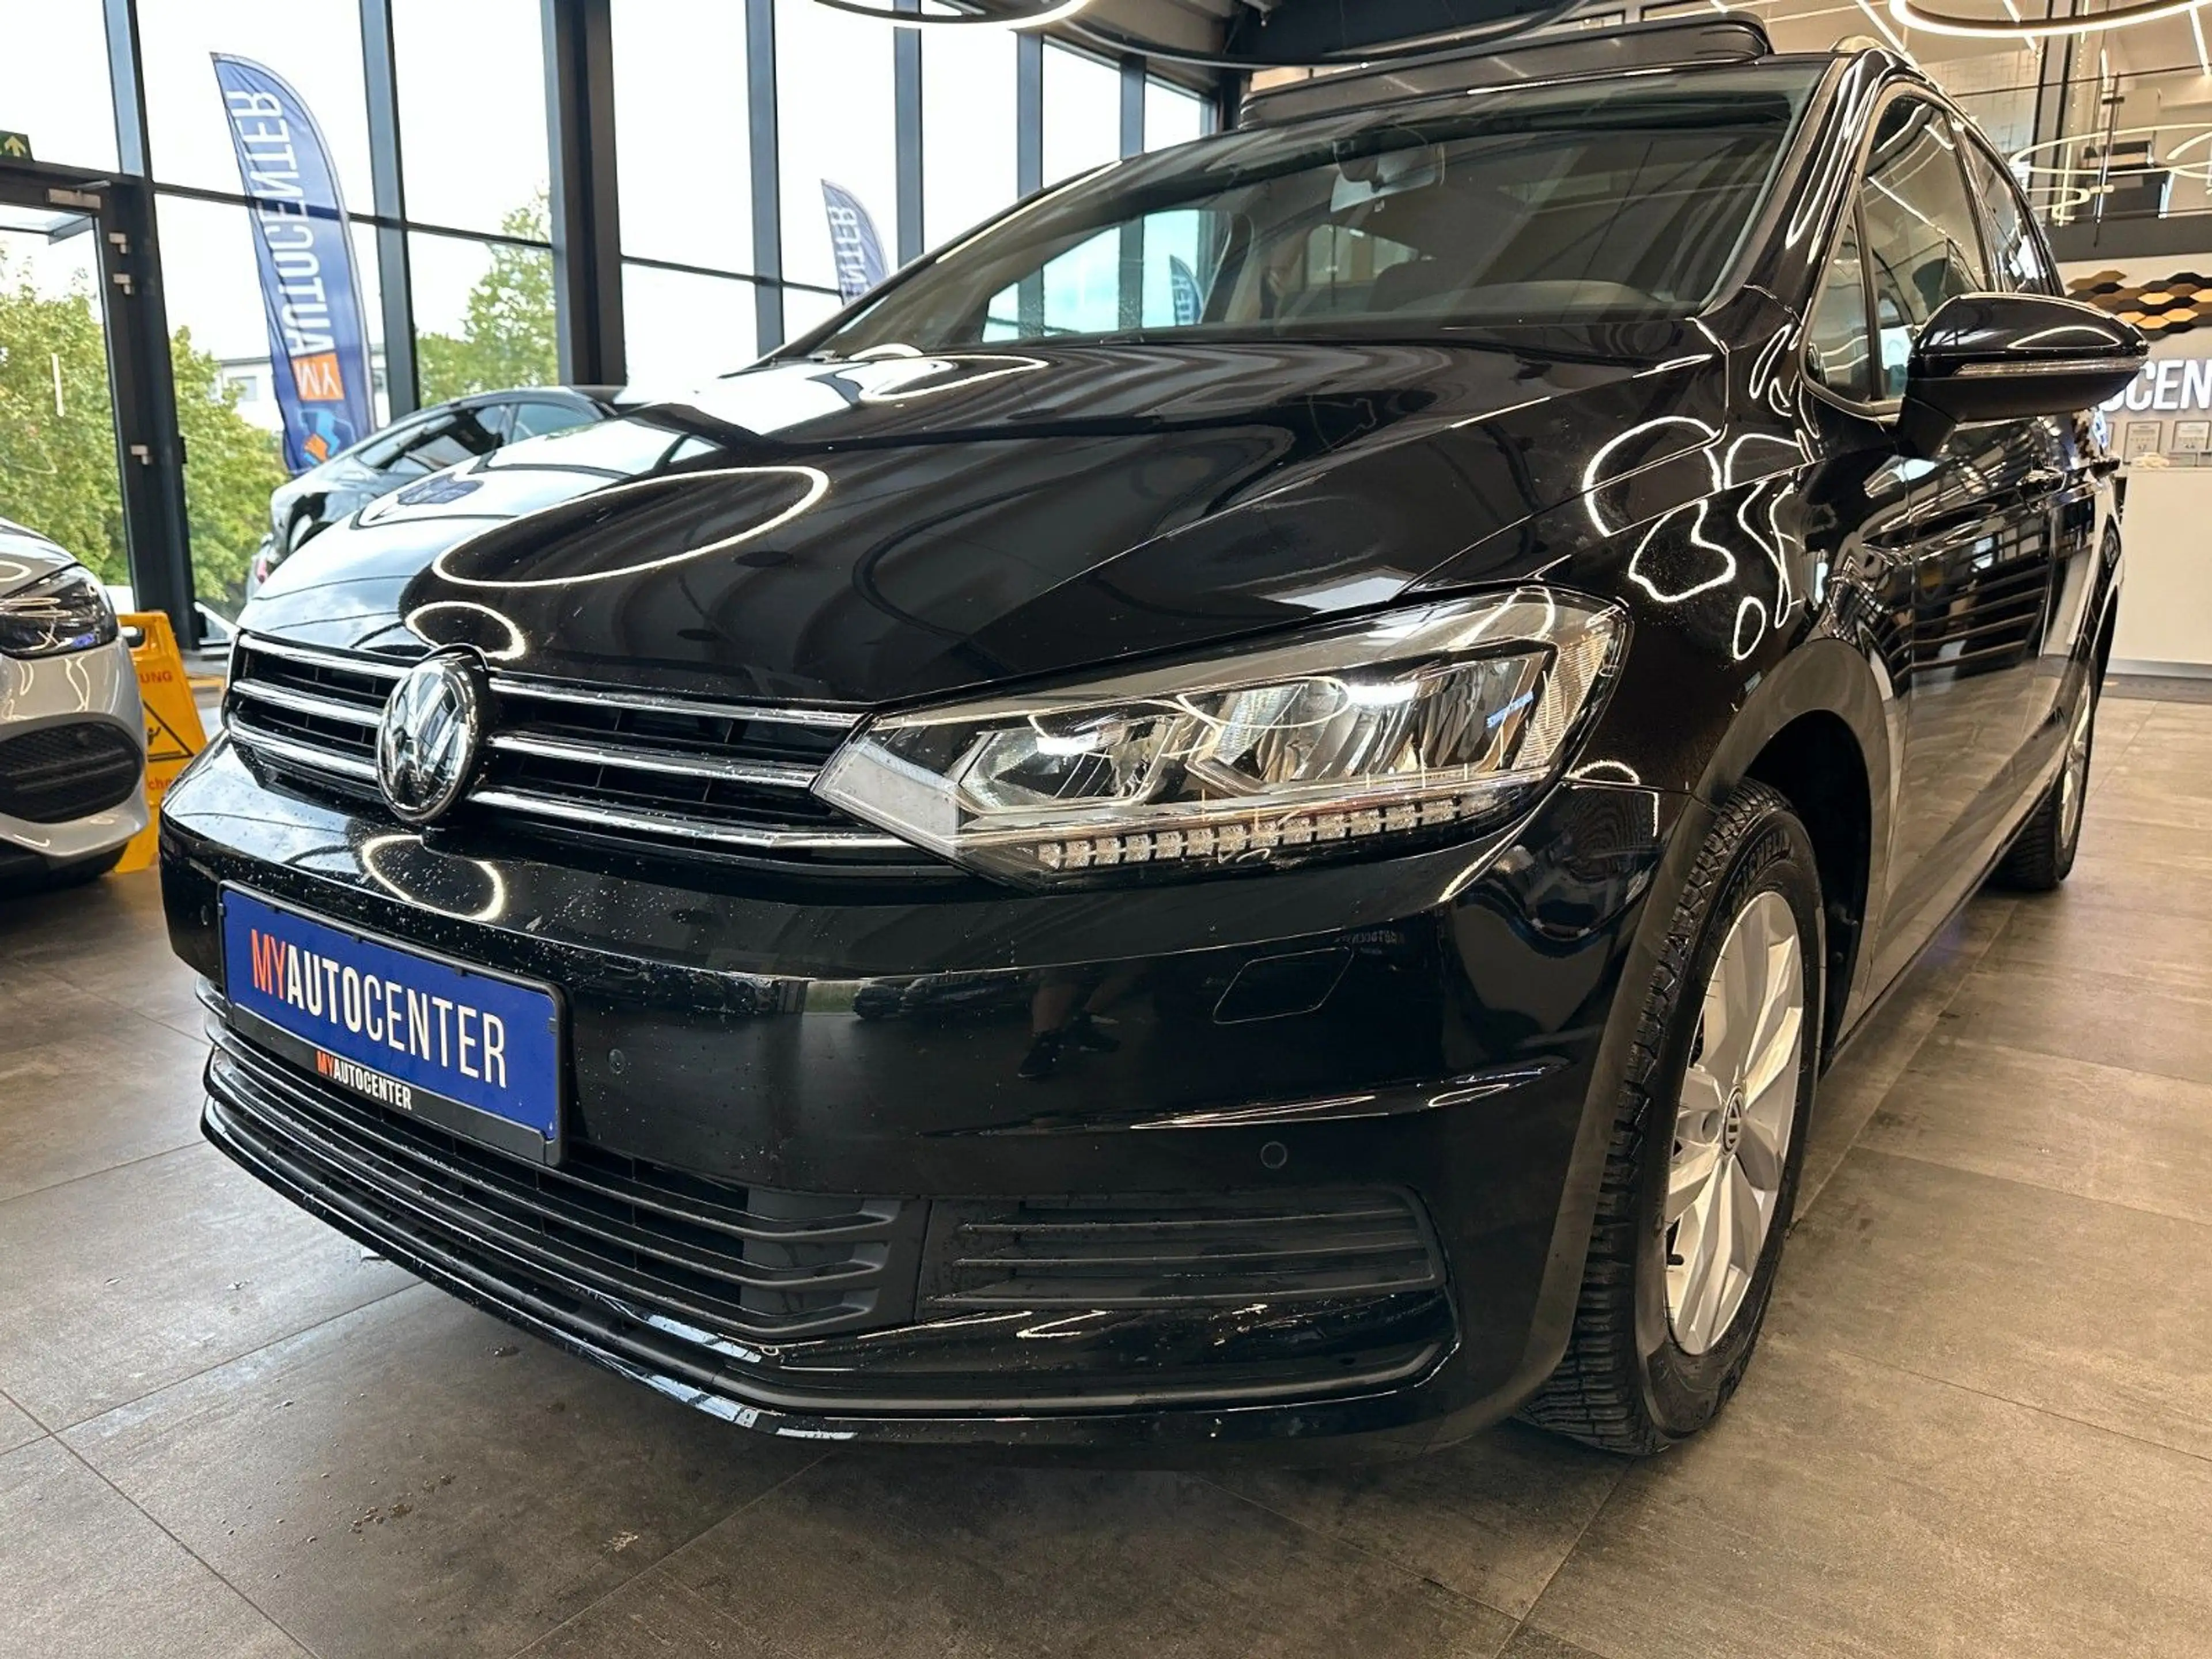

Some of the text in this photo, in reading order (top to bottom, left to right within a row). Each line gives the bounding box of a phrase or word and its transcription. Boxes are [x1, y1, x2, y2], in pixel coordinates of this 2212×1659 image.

[2099, 359, 2212, 411] CEN
[251, 928, 507, 1089] MYAUTOCENTER
[316, 1050, 412, 1111] MYAUTOCENTER
